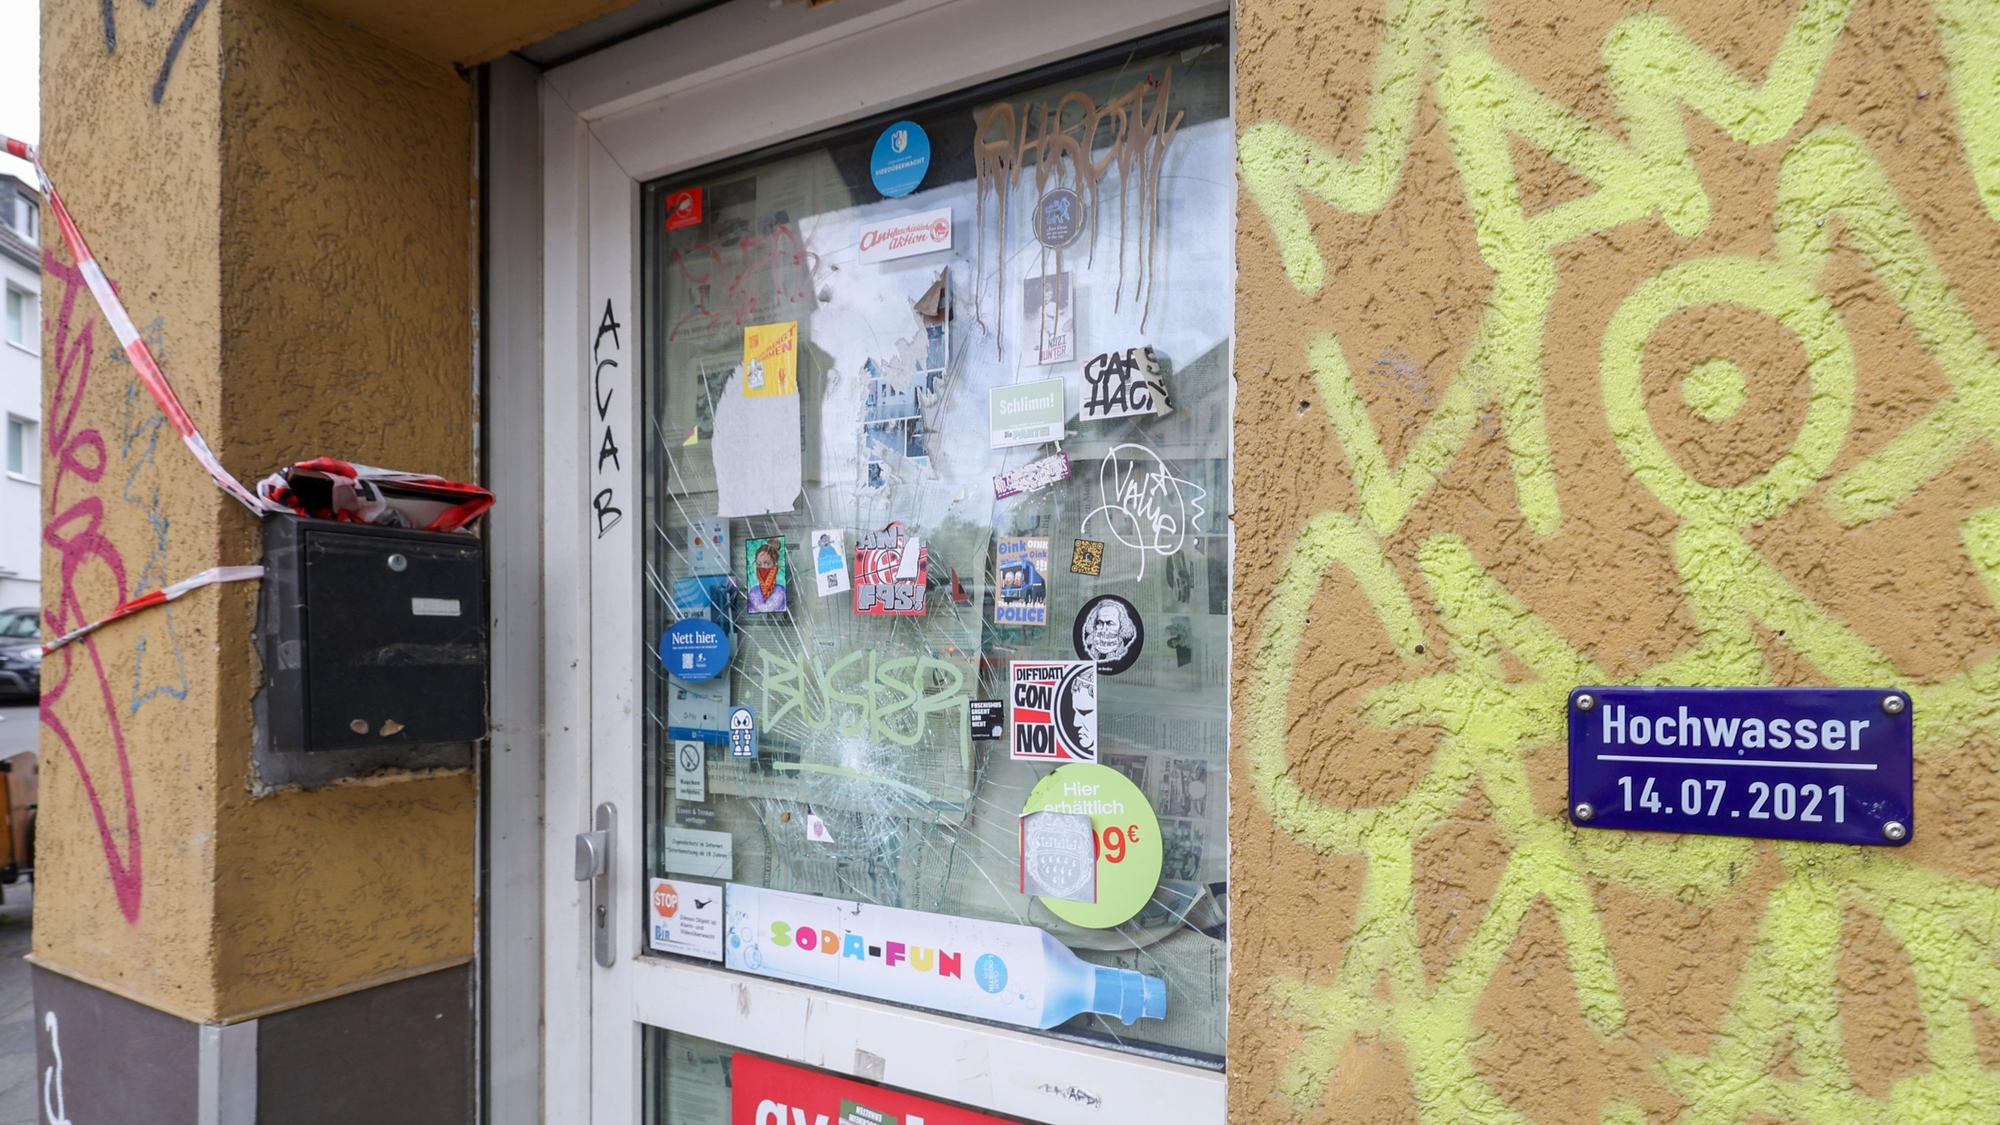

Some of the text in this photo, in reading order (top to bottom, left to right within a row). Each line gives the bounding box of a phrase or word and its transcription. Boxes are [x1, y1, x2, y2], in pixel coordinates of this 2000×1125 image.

[1000, 392, 1055, 416] Schlimm!
[997, 607, 1045, 622] POLICE
[672, 631, 718, 645] Nett hier.
[1014, 683, 1052, 710] CON
[1016, 724, 1055, 754] NOI
[1602, 704, 1870, 751] Hochwasser
[1063, 782, 1100, 797] Hier
[1618, 776, 1845, 823] 14.07.2021
[1044, 798, 1124, 815] erhältlich
[655, 892, 678, 909] STOP
[771, 920, 961, 980] SODA-FUN
